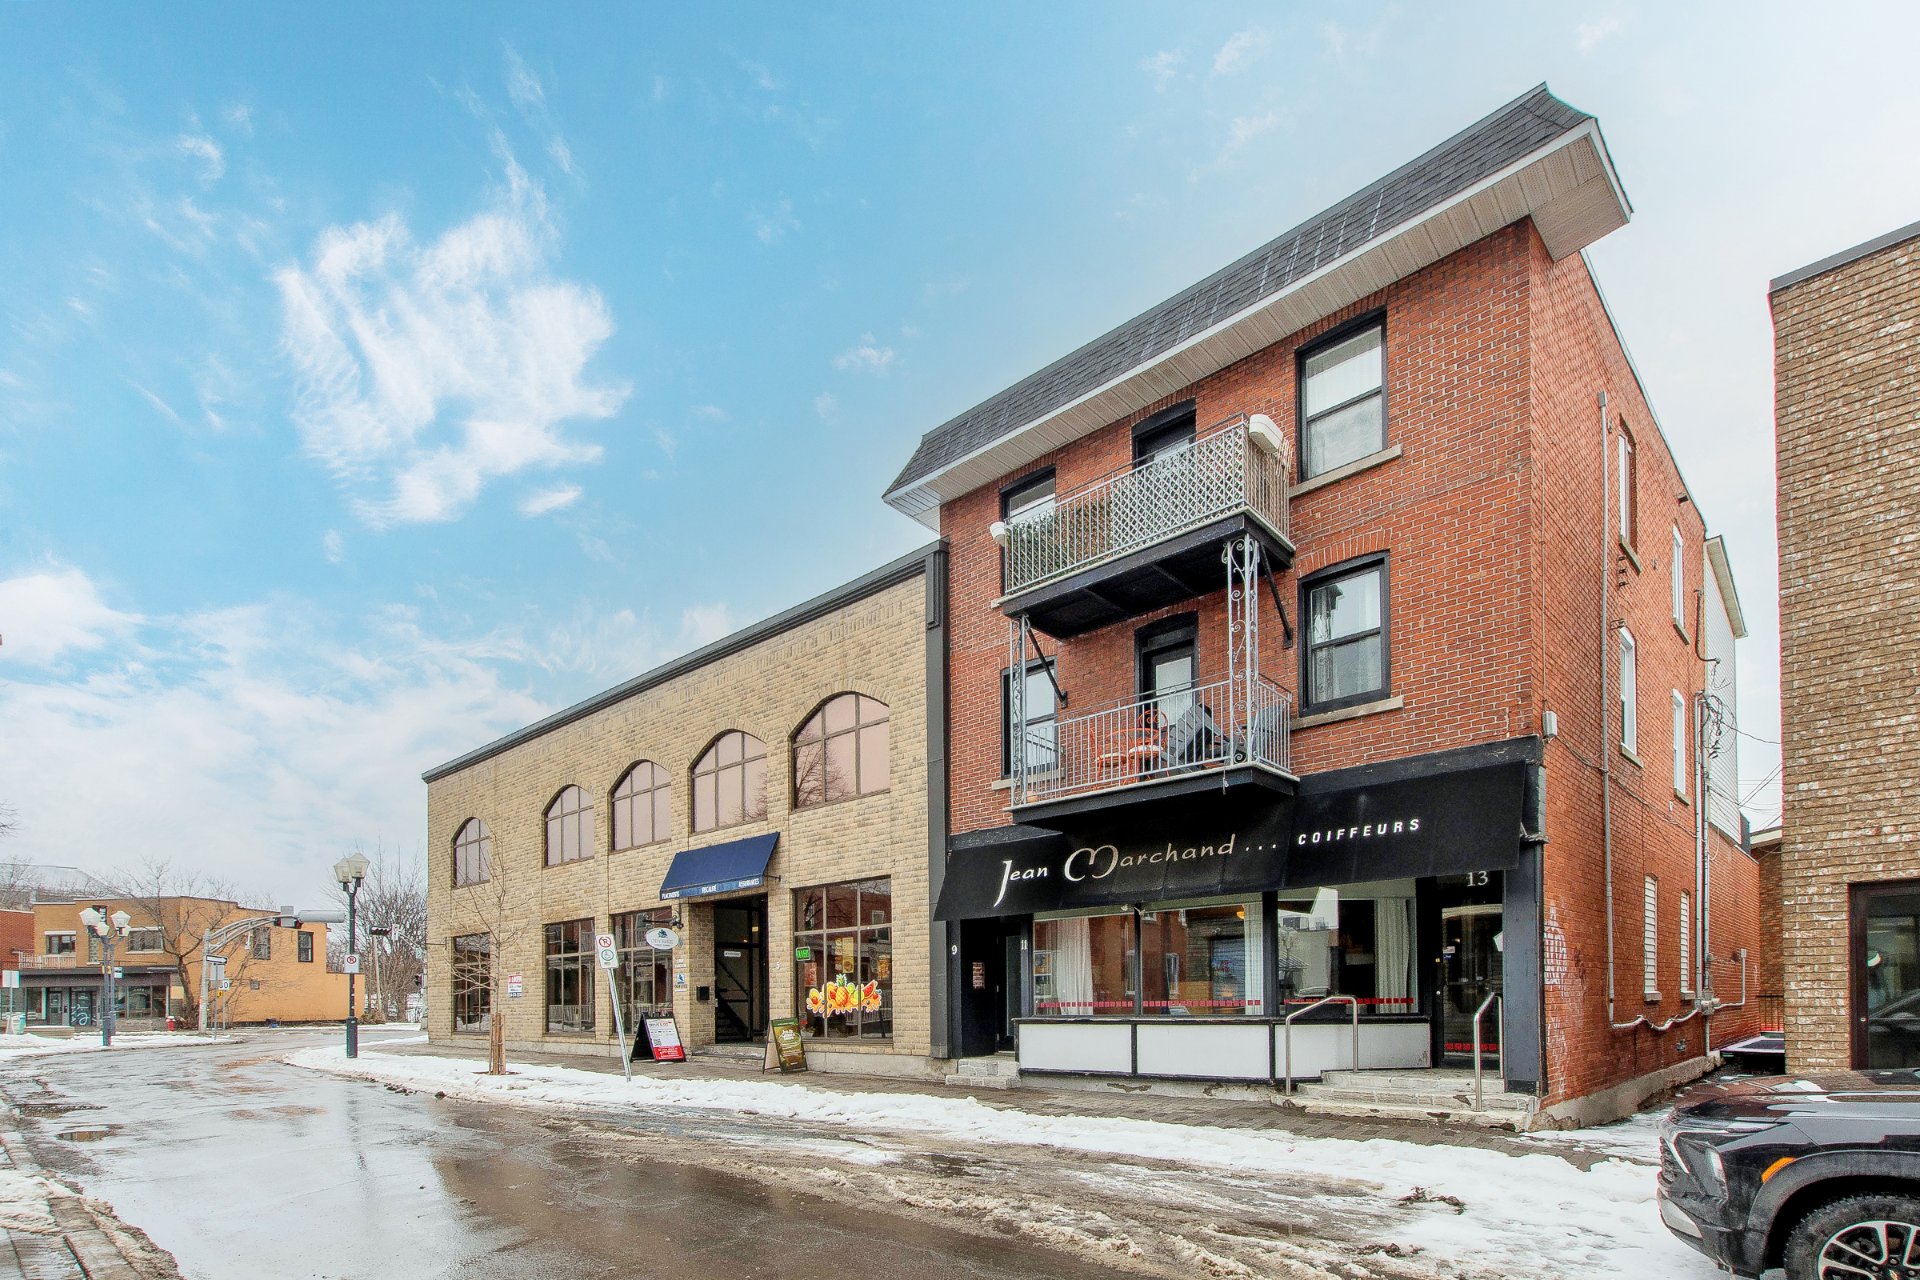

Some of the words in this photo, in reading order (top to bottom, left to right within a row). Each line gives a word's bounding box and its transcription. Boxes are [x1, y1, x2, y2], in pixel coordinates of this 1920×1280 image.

[993, 859, 1049, 907] Jean
[1298, 818, 1420, 845] COIFFEURS
[1467, 870, 1489, 887] 13
[951, 944, 958, 955] 9
[1020, 939, 1028, 950] 11
